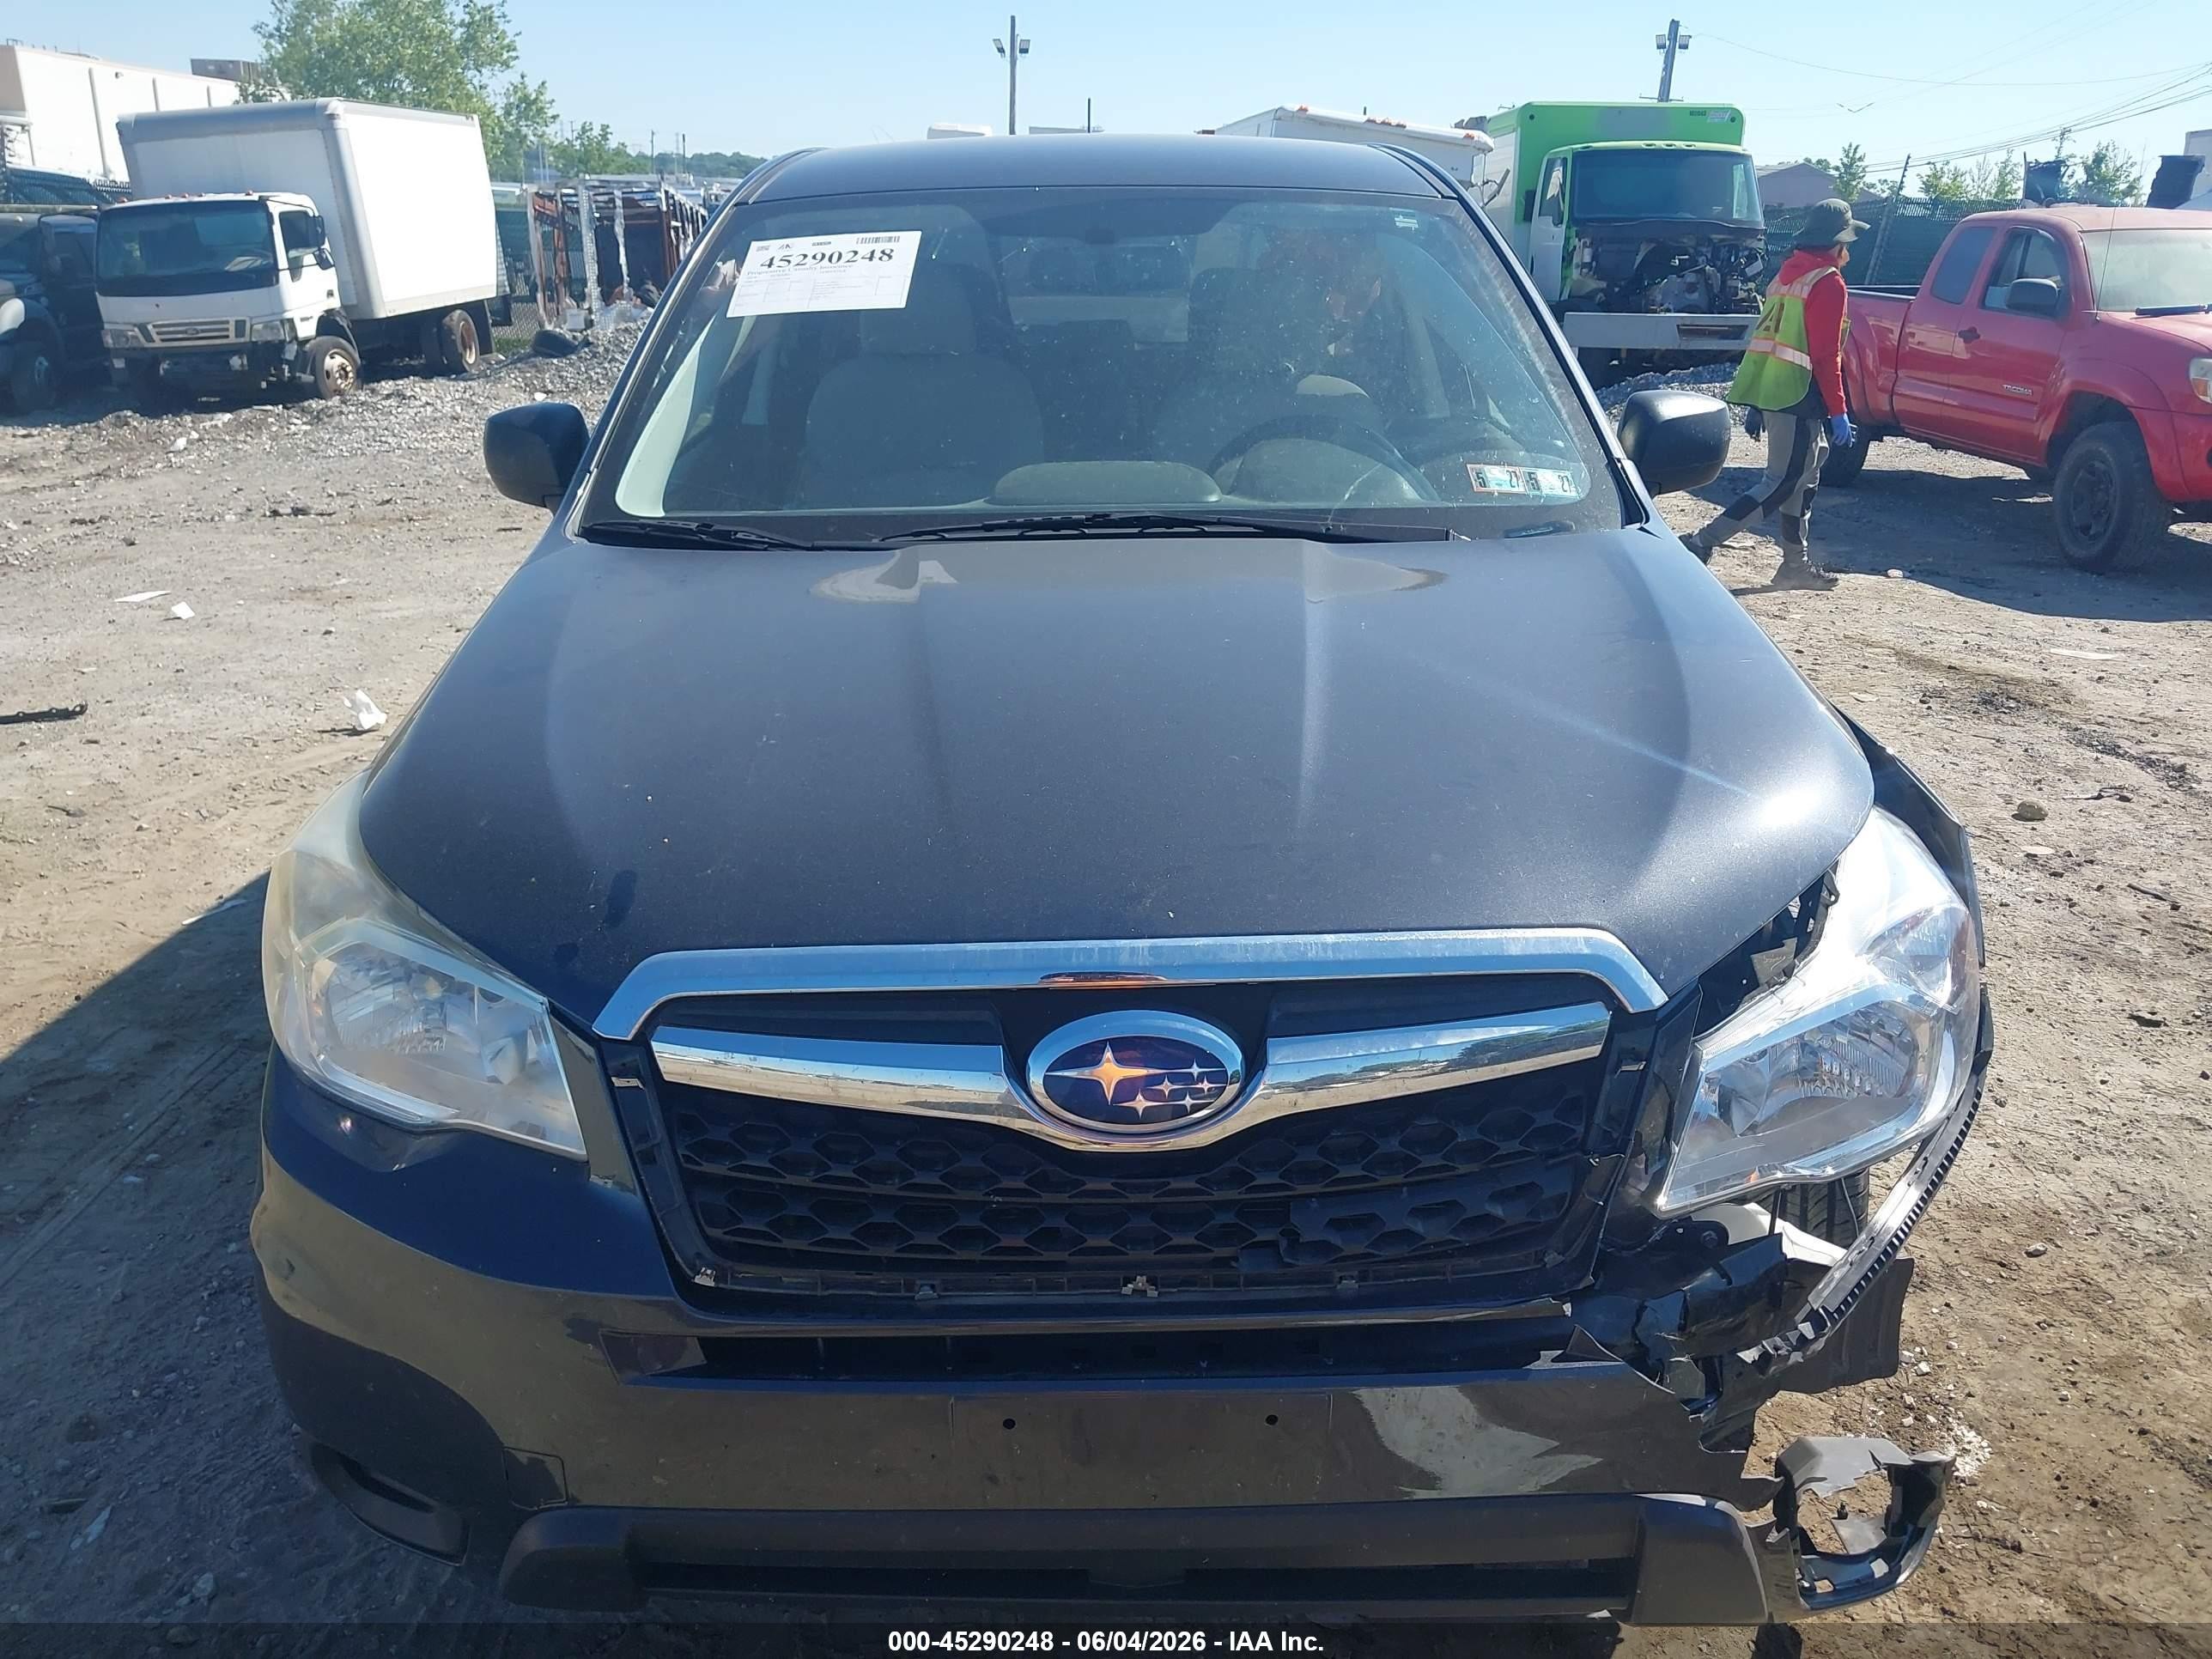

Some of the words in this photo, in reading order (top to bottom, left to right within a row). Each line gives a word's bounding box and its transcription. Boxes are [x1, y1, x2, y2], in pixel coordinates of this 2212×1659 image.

[760, 247, 895, 269] 45290248
[1474, 471, 1487, 489] 5
[1505, 470, 1521, 489] 27
[1527, 471, 1540, 491] 5
